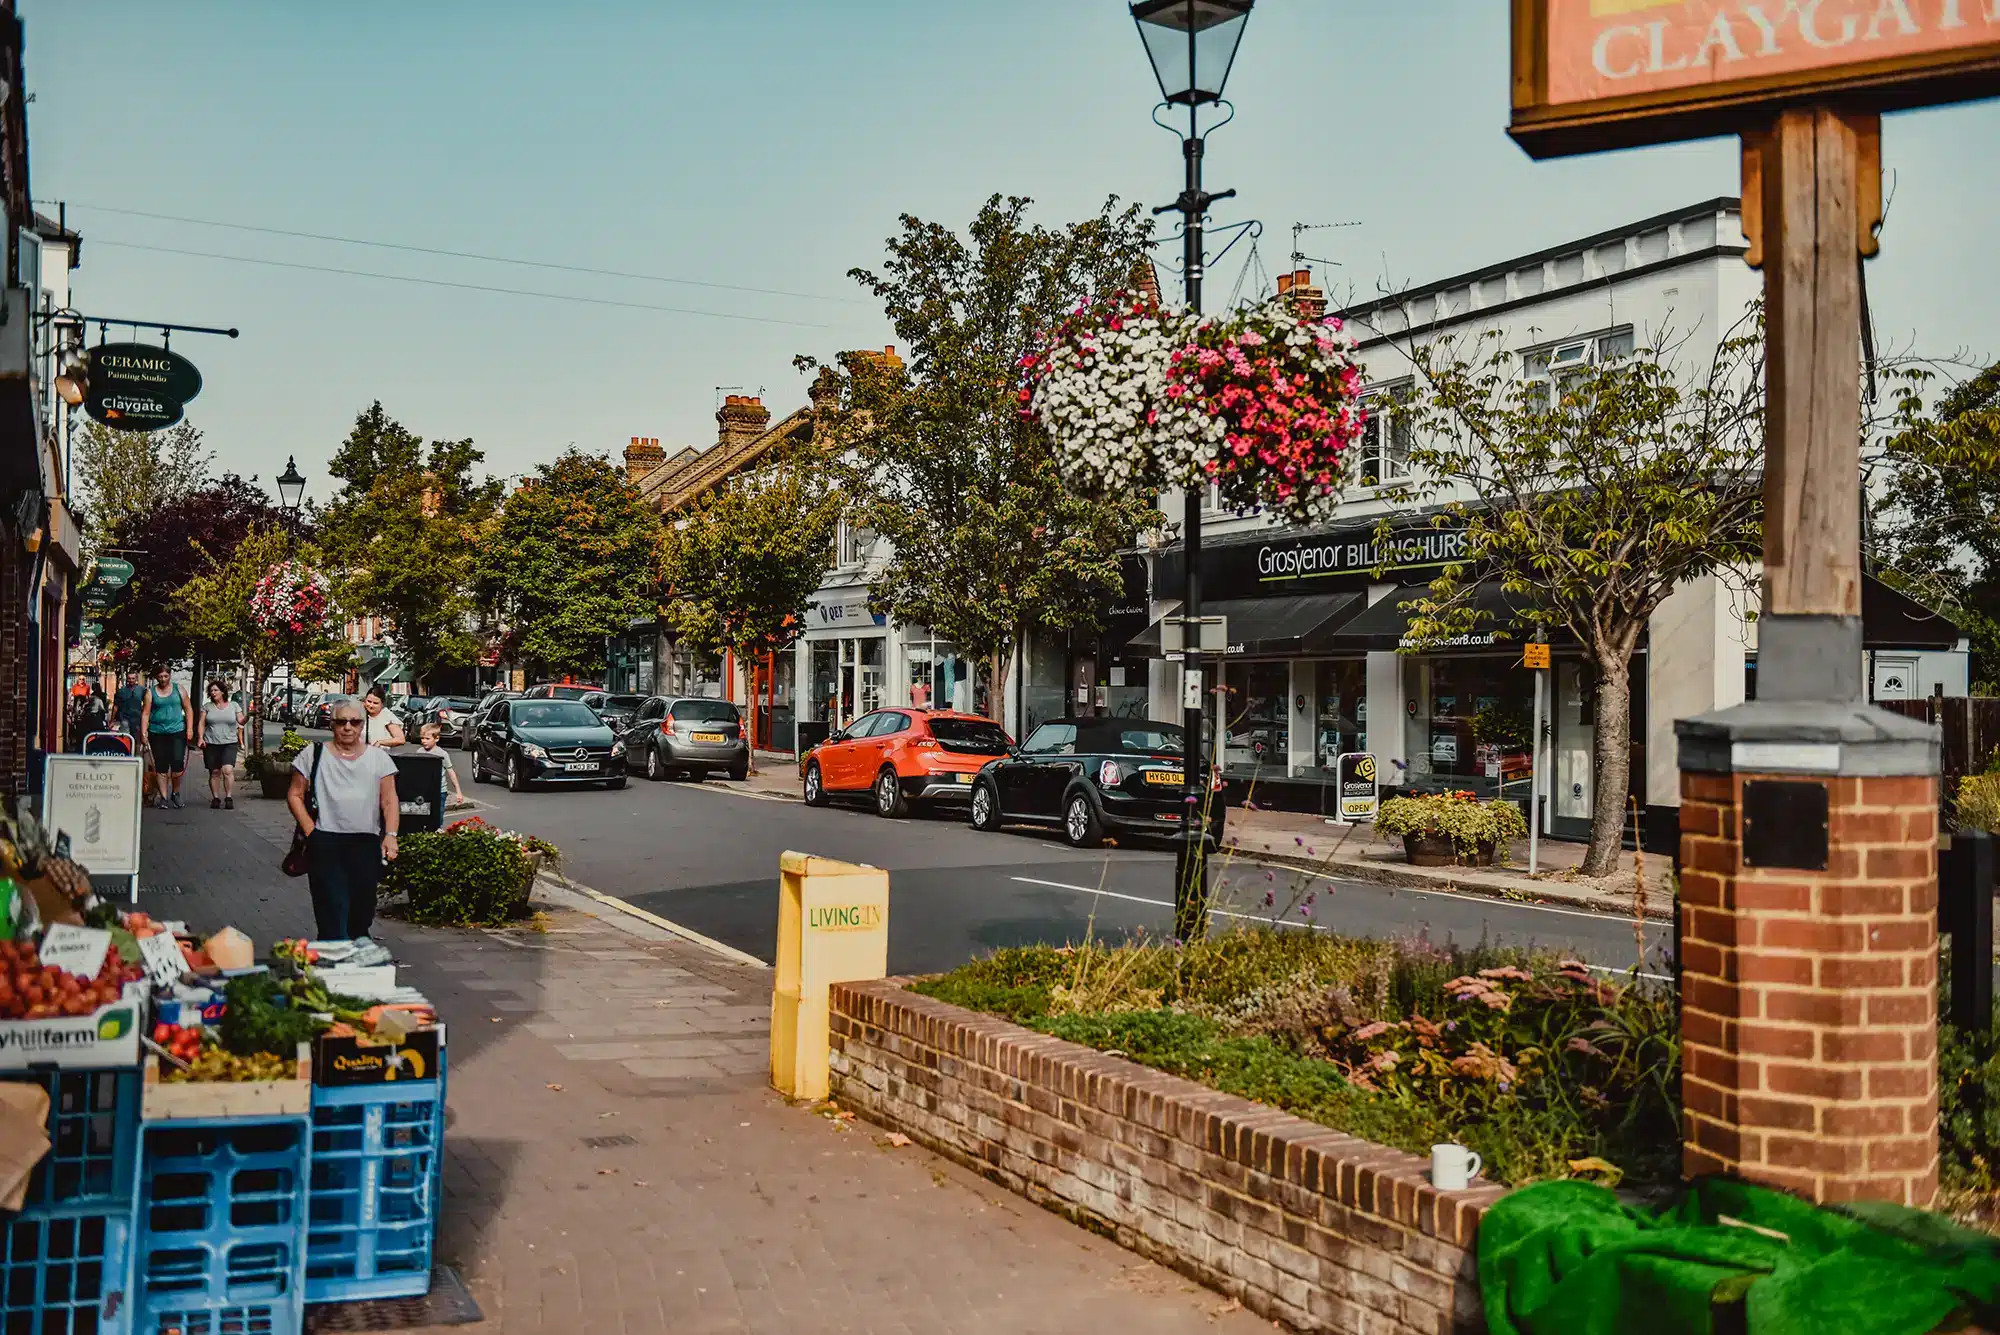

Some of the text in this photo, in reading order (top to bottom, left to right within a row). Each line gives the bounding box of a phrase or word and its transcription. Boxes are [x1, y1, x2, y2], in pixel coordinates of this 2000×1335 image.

[1591, 0, 2000, 80] CLAYGA
[101, 356, 170, 371] CERAMIC
[107, 371, 167, 383] Painting Studio
[102, 398, 163, 412] Claygate
[1258, 543, 1342, 575] Grosvenor
[829, 605, 844, 621] QEF
[1126, 604, 1144, 614] Cuisine
[76, 773, 115, 781] ELLIOT
[1149, 772, 1184, 782] HY60 OL
[1344, 781, 1373, 790] Grosvenor
[1348, 804, 1370, 813] OPEN
[810, 906, 860, 927] LIVING
[333, 1054, 383, 1071] Quality
